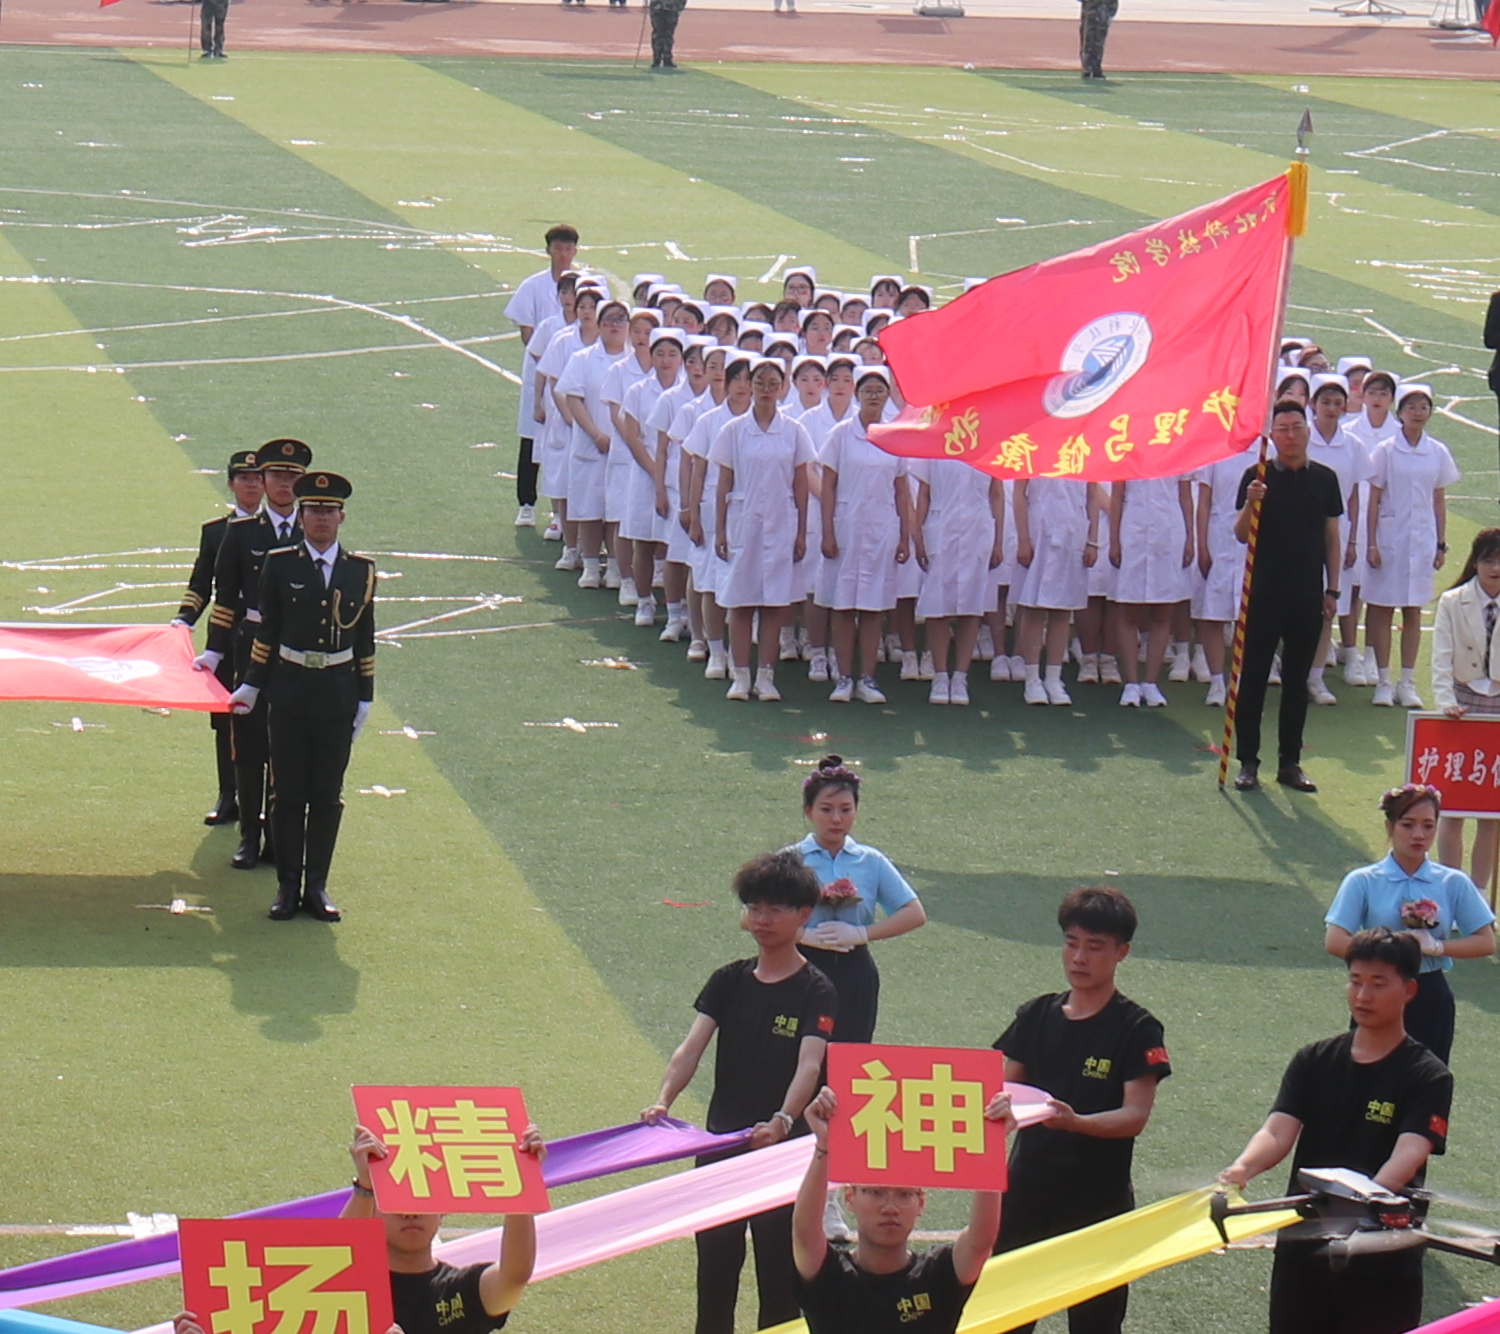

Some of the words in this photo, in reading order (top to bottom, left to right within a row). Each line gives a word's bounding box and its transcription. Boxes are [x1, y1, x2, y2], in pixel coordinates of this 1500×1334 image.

[774, 1014, 799, 1032] 中国
[1084, 1056, 1112, 1074] 中国
[850, 1059, 986, 1173] 神
[1366, 1099, 1396, 1118] 中国
[375, 1098, 525, 1199] 精
[435, 1292, 464, 1317] 中国
[896, 1292, 932, 1313] 中国
